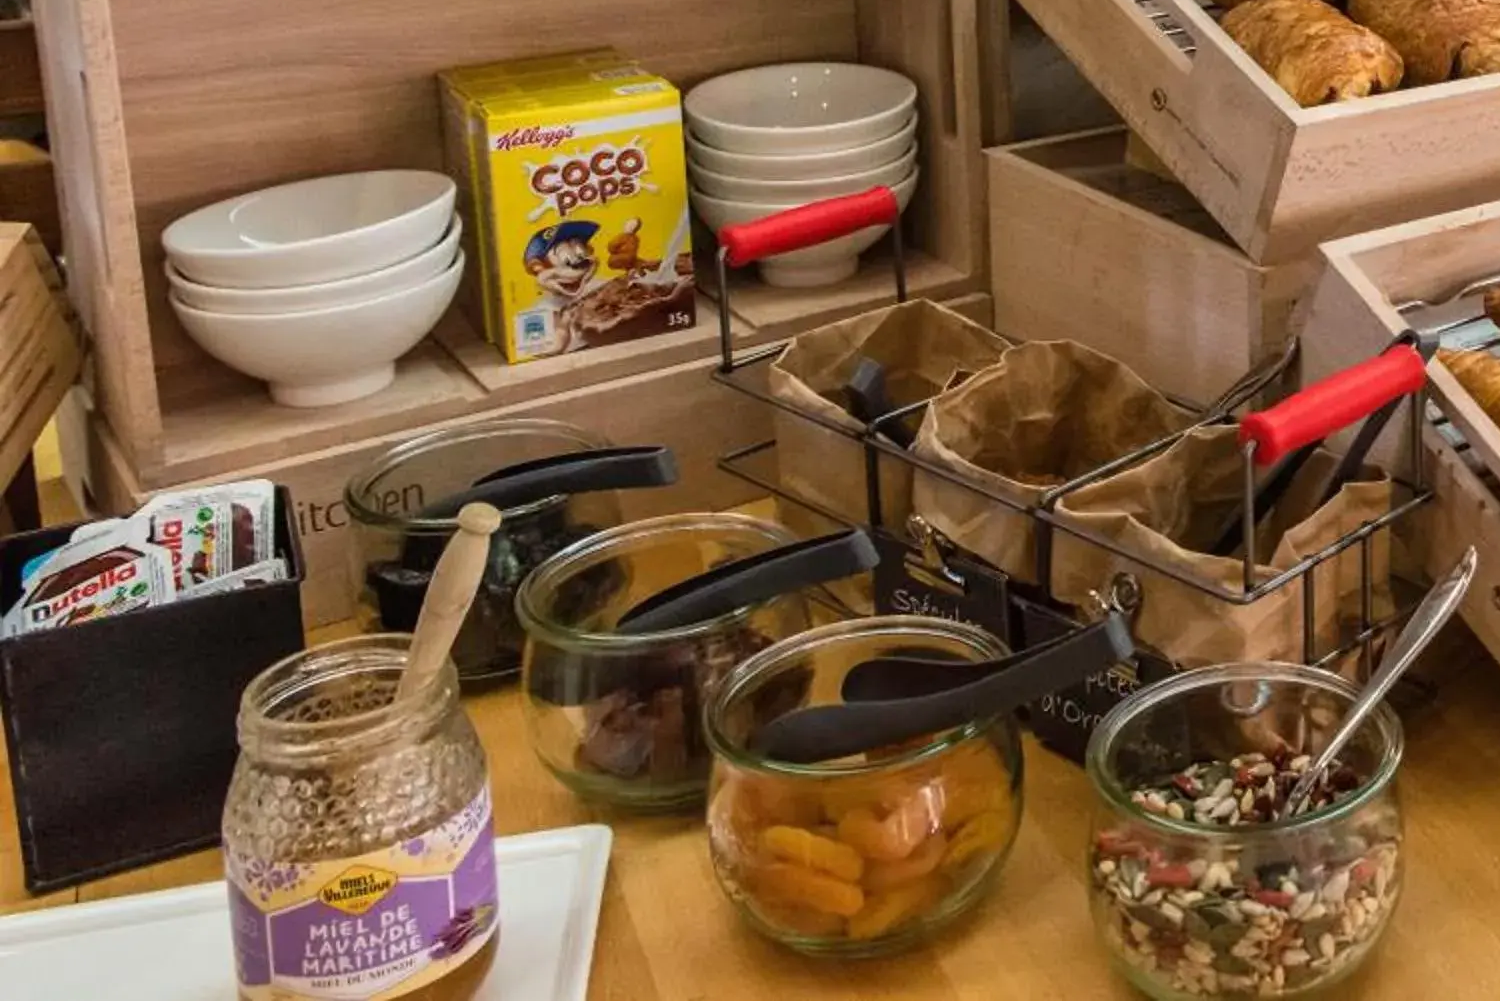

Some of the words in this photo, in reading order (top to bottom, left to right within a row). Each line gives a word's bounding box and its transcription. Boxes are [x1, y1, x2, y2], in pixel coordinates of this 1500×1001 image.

[496, 125, 575, 151] Kellogg's
[32, 564, 136, 623] nutella
[381, 903, 411, 928] DE
[305, 918, 418, 959] LAVANDE
